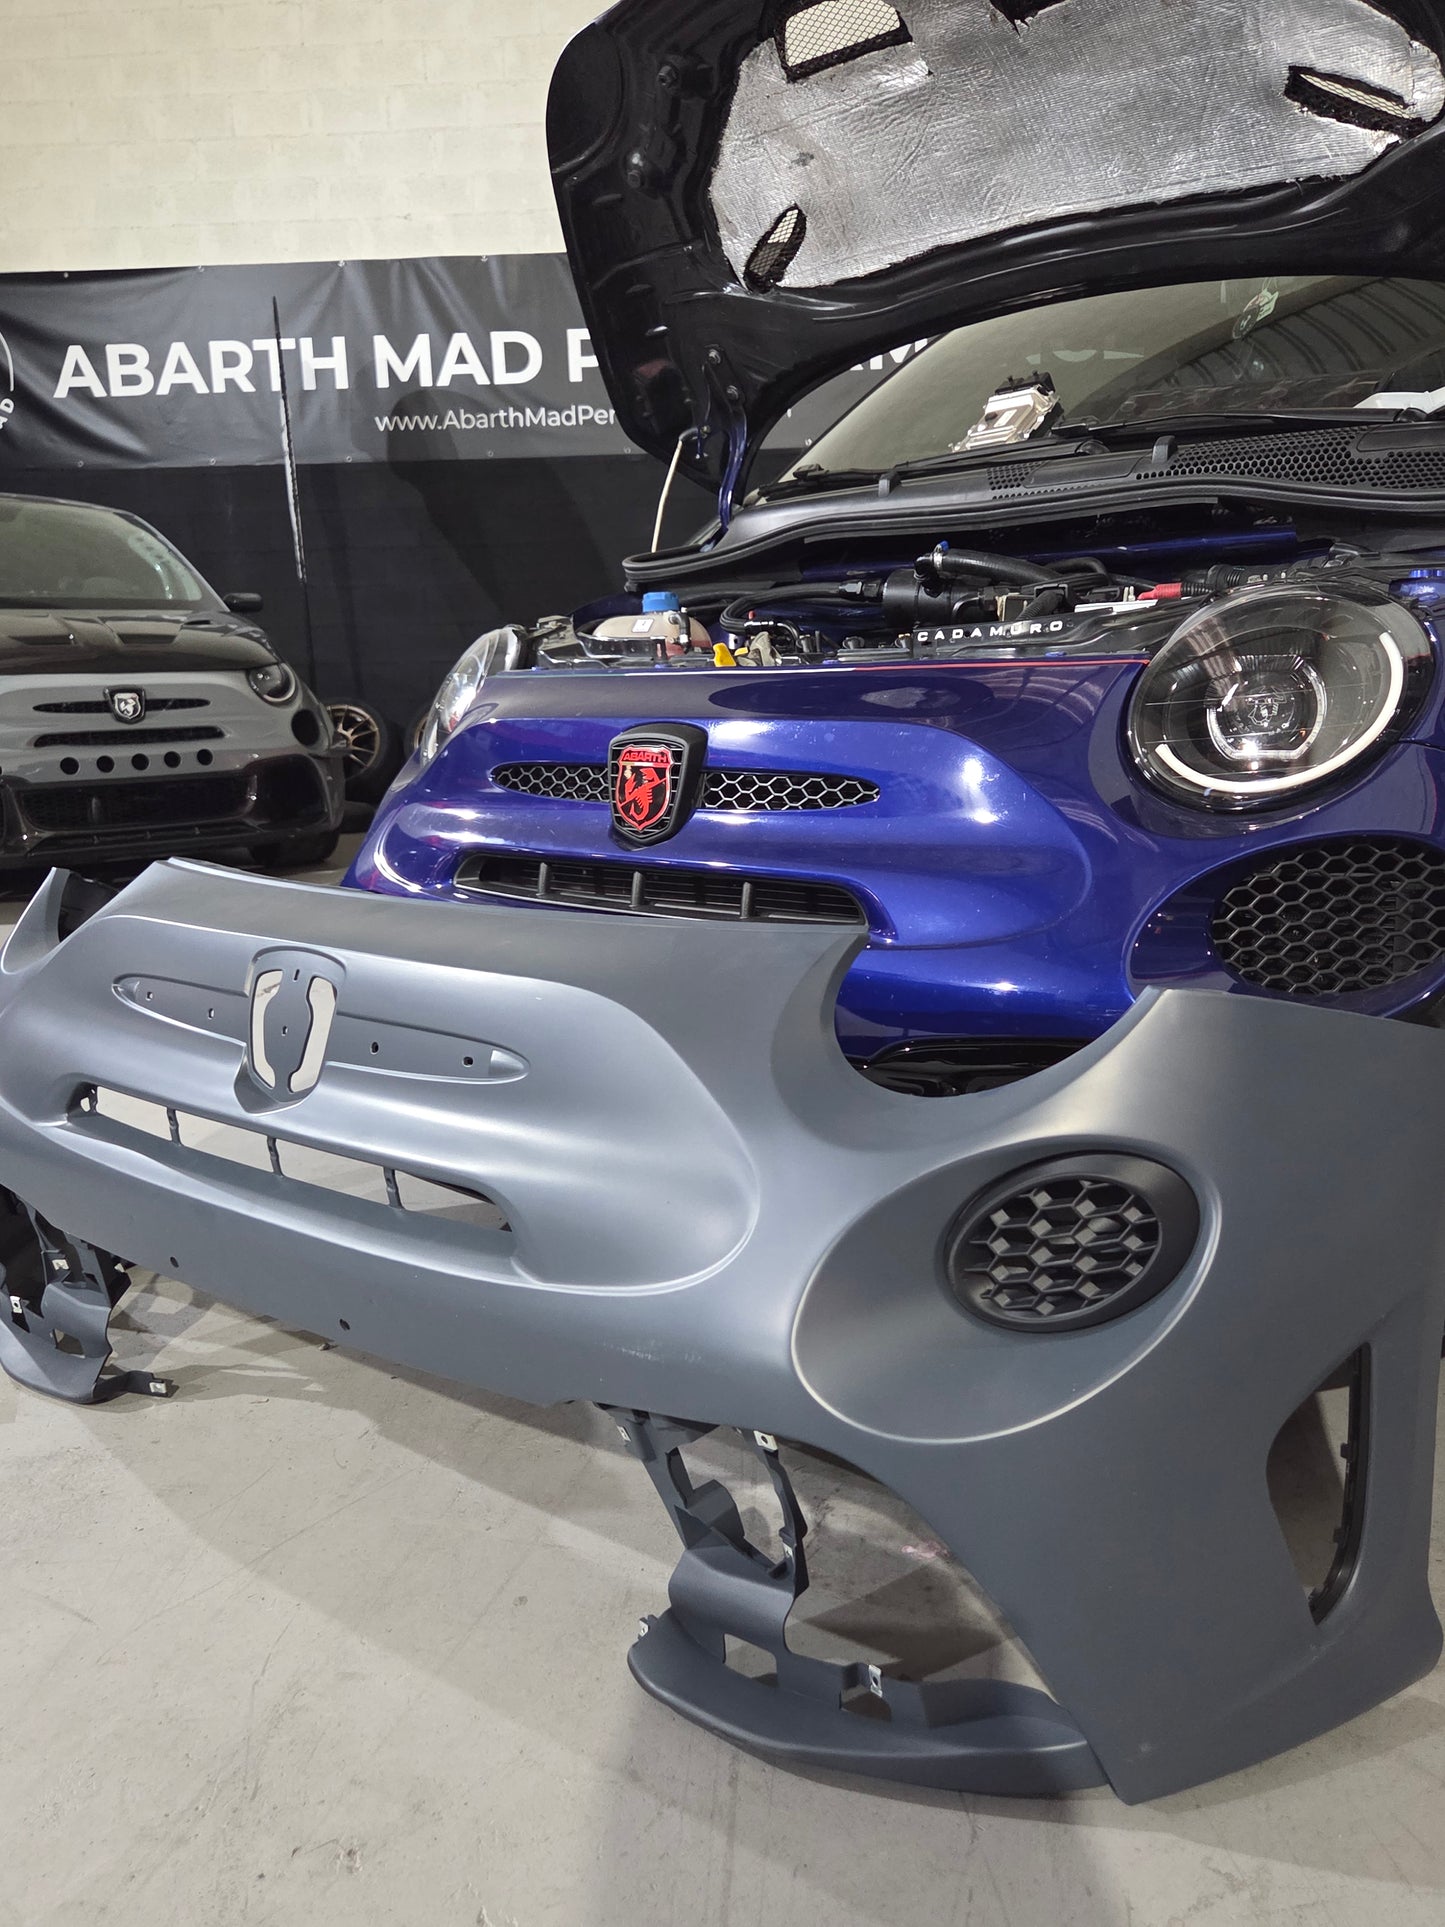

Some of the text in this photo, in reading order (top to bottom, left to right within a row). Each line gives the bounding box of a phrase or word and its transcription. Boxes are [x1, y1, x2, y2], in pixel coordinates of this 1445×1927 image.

[53, 336, 349, 398] ABARTH
[373, 332, 543, 389] MAD
[918, 620, 1063, 642] CADAMURO
[624, 752, 667, 763] ABARTH
